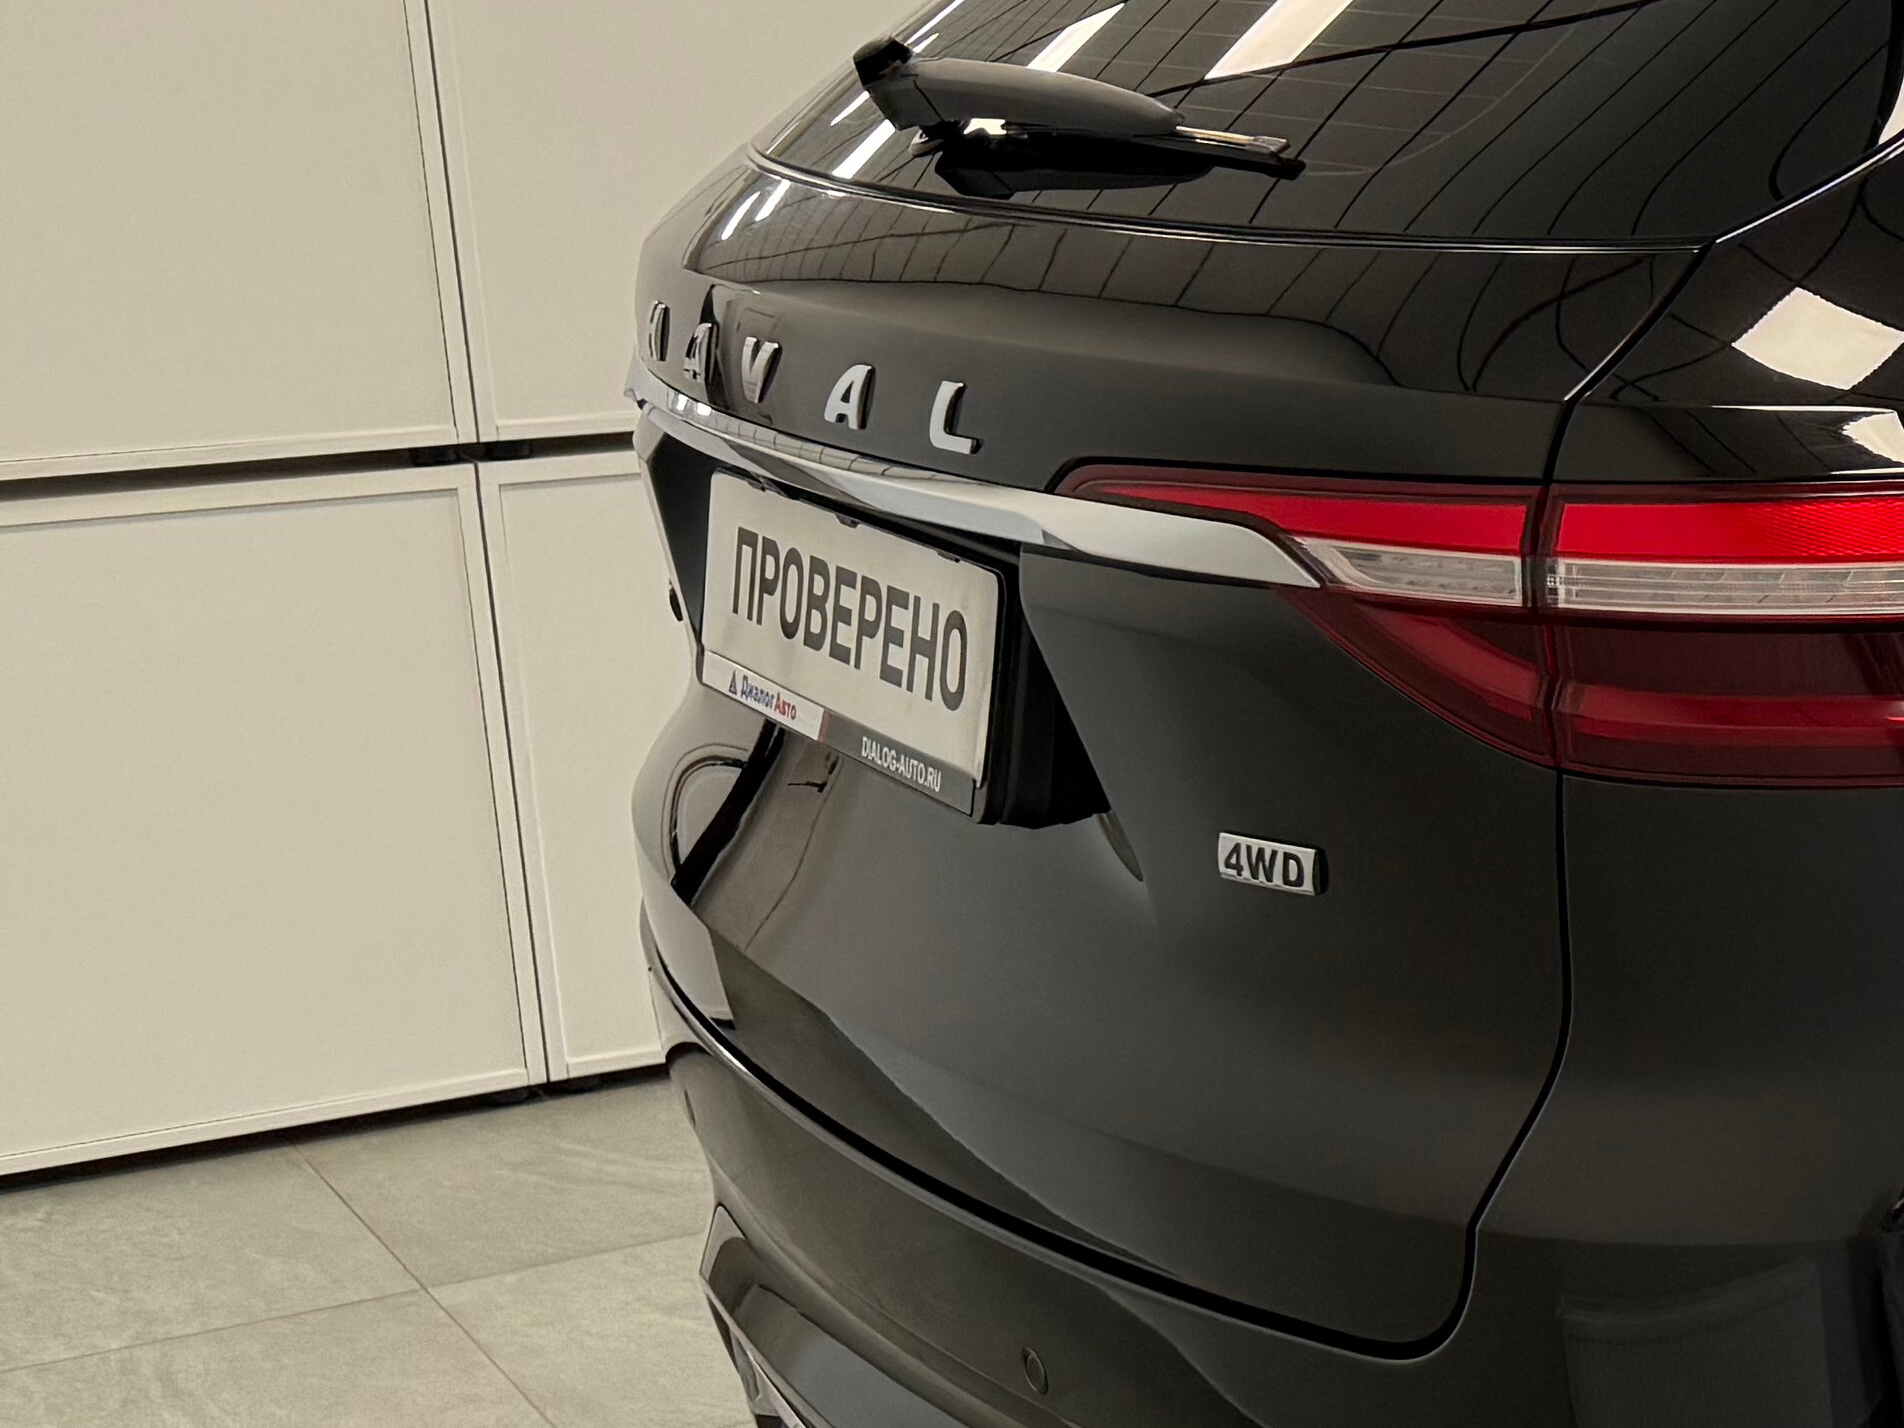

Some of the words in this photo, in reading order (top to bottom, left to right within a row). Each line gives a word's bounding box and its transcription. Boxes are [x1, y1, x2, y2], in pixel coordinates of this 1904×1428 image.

[649, 300, 981, 455] HAVAL
[732, 526, 968, 711] ПРОВЕРЕНО
[861, 736, 941, 792] DIALOG-AUTO.RU
[1224, 841, 1305, 890] 4WD
